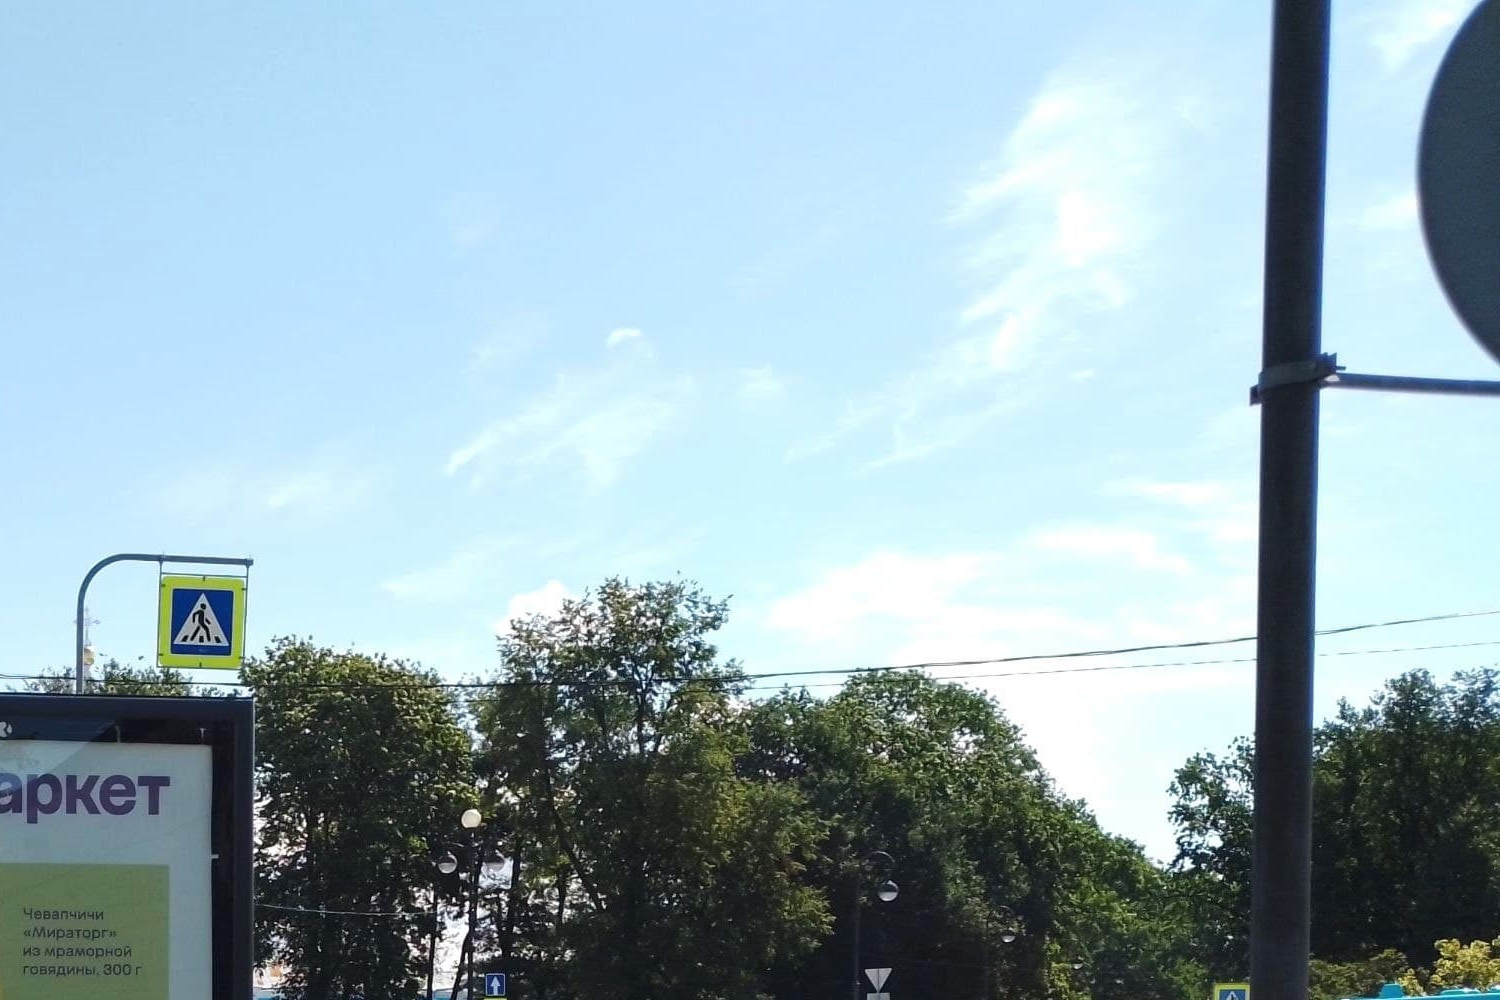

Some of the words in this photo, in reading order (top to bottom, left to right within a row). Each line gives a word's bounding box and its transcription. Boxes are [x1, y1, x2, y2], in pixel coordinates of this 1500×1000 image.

[23, 908, 104, 921] Чевапчичи
[23, 927, 117, 941] «Мираторг»
[23, 947, 40, 957] из
[44, 945, 132, 959] мраморной
[23, 965, 100, 977] говядины,
[102, 964, 132, 976] 300
[135, 966, 143, 976] г
